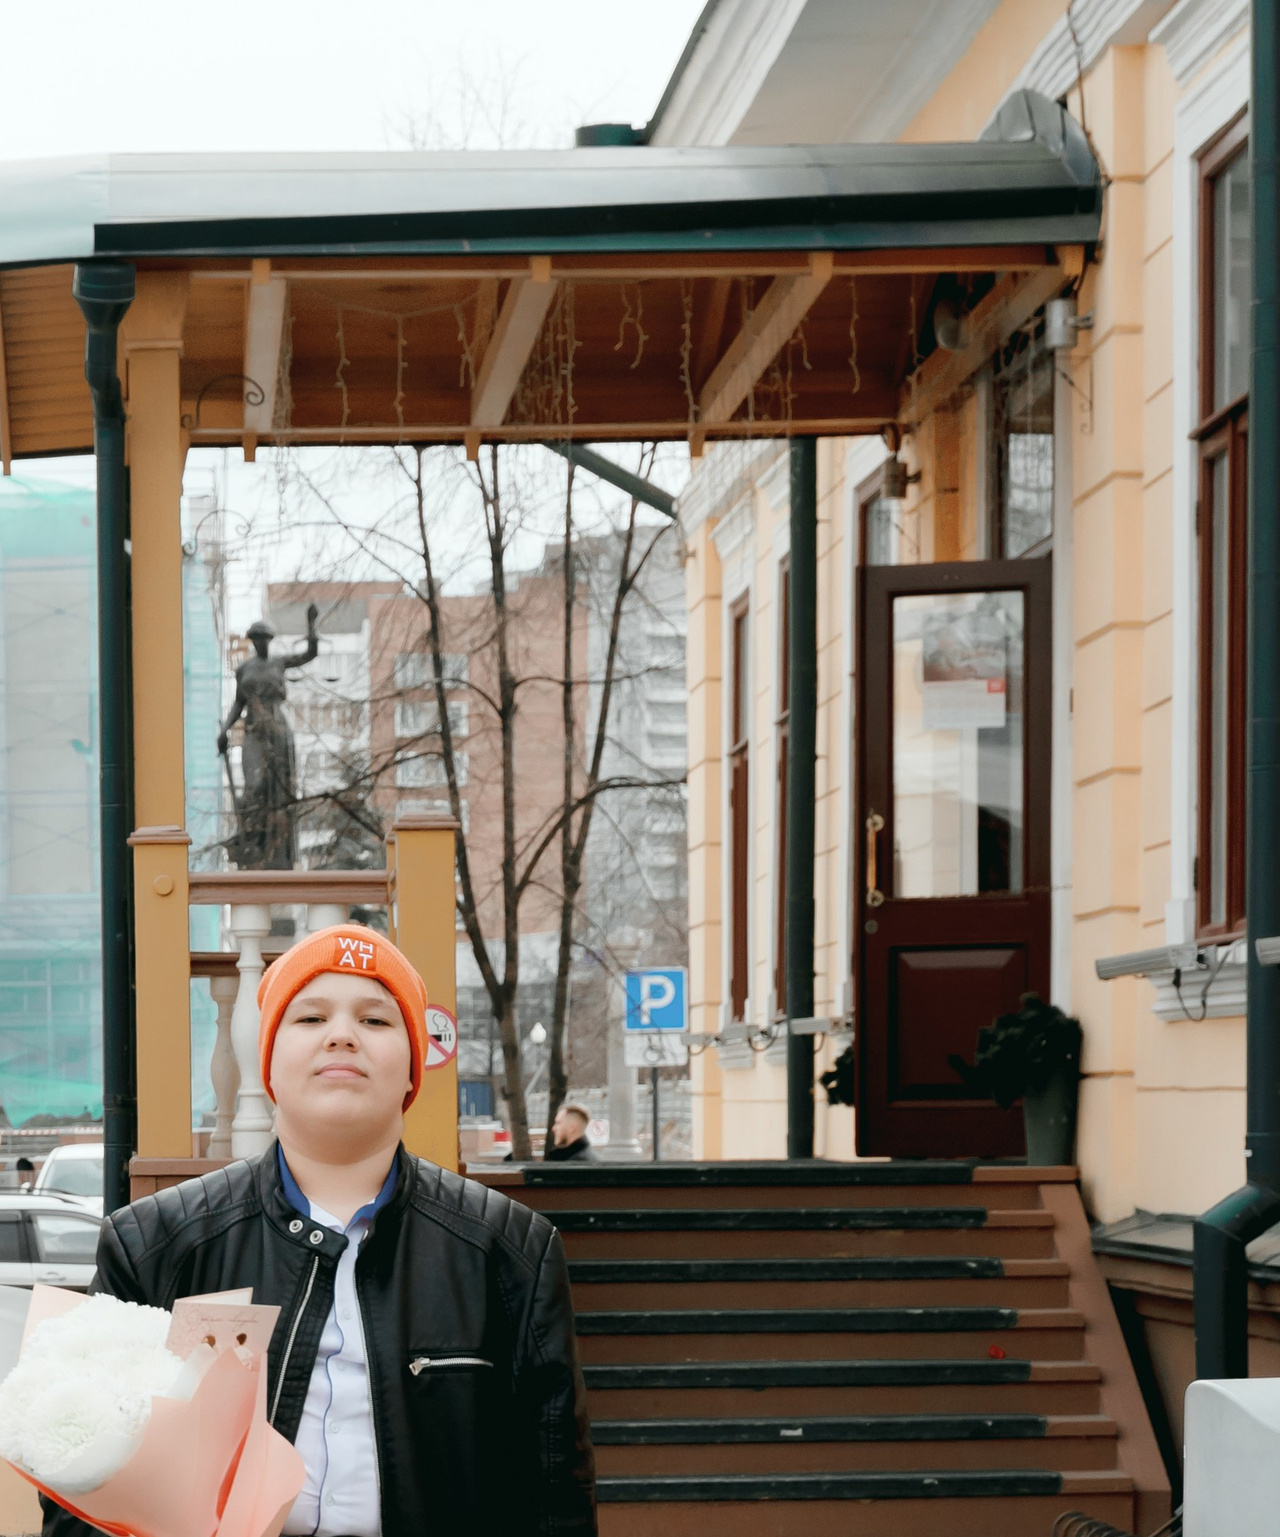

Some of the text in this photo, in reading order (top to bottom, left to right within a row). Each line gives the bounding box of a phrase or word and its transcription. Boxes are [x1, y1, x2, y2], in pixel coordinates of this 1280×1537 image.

[338, 937, 373, 954] WH
[339, 950, 373, 969] AT
[640, 975, 676, 1025] P
